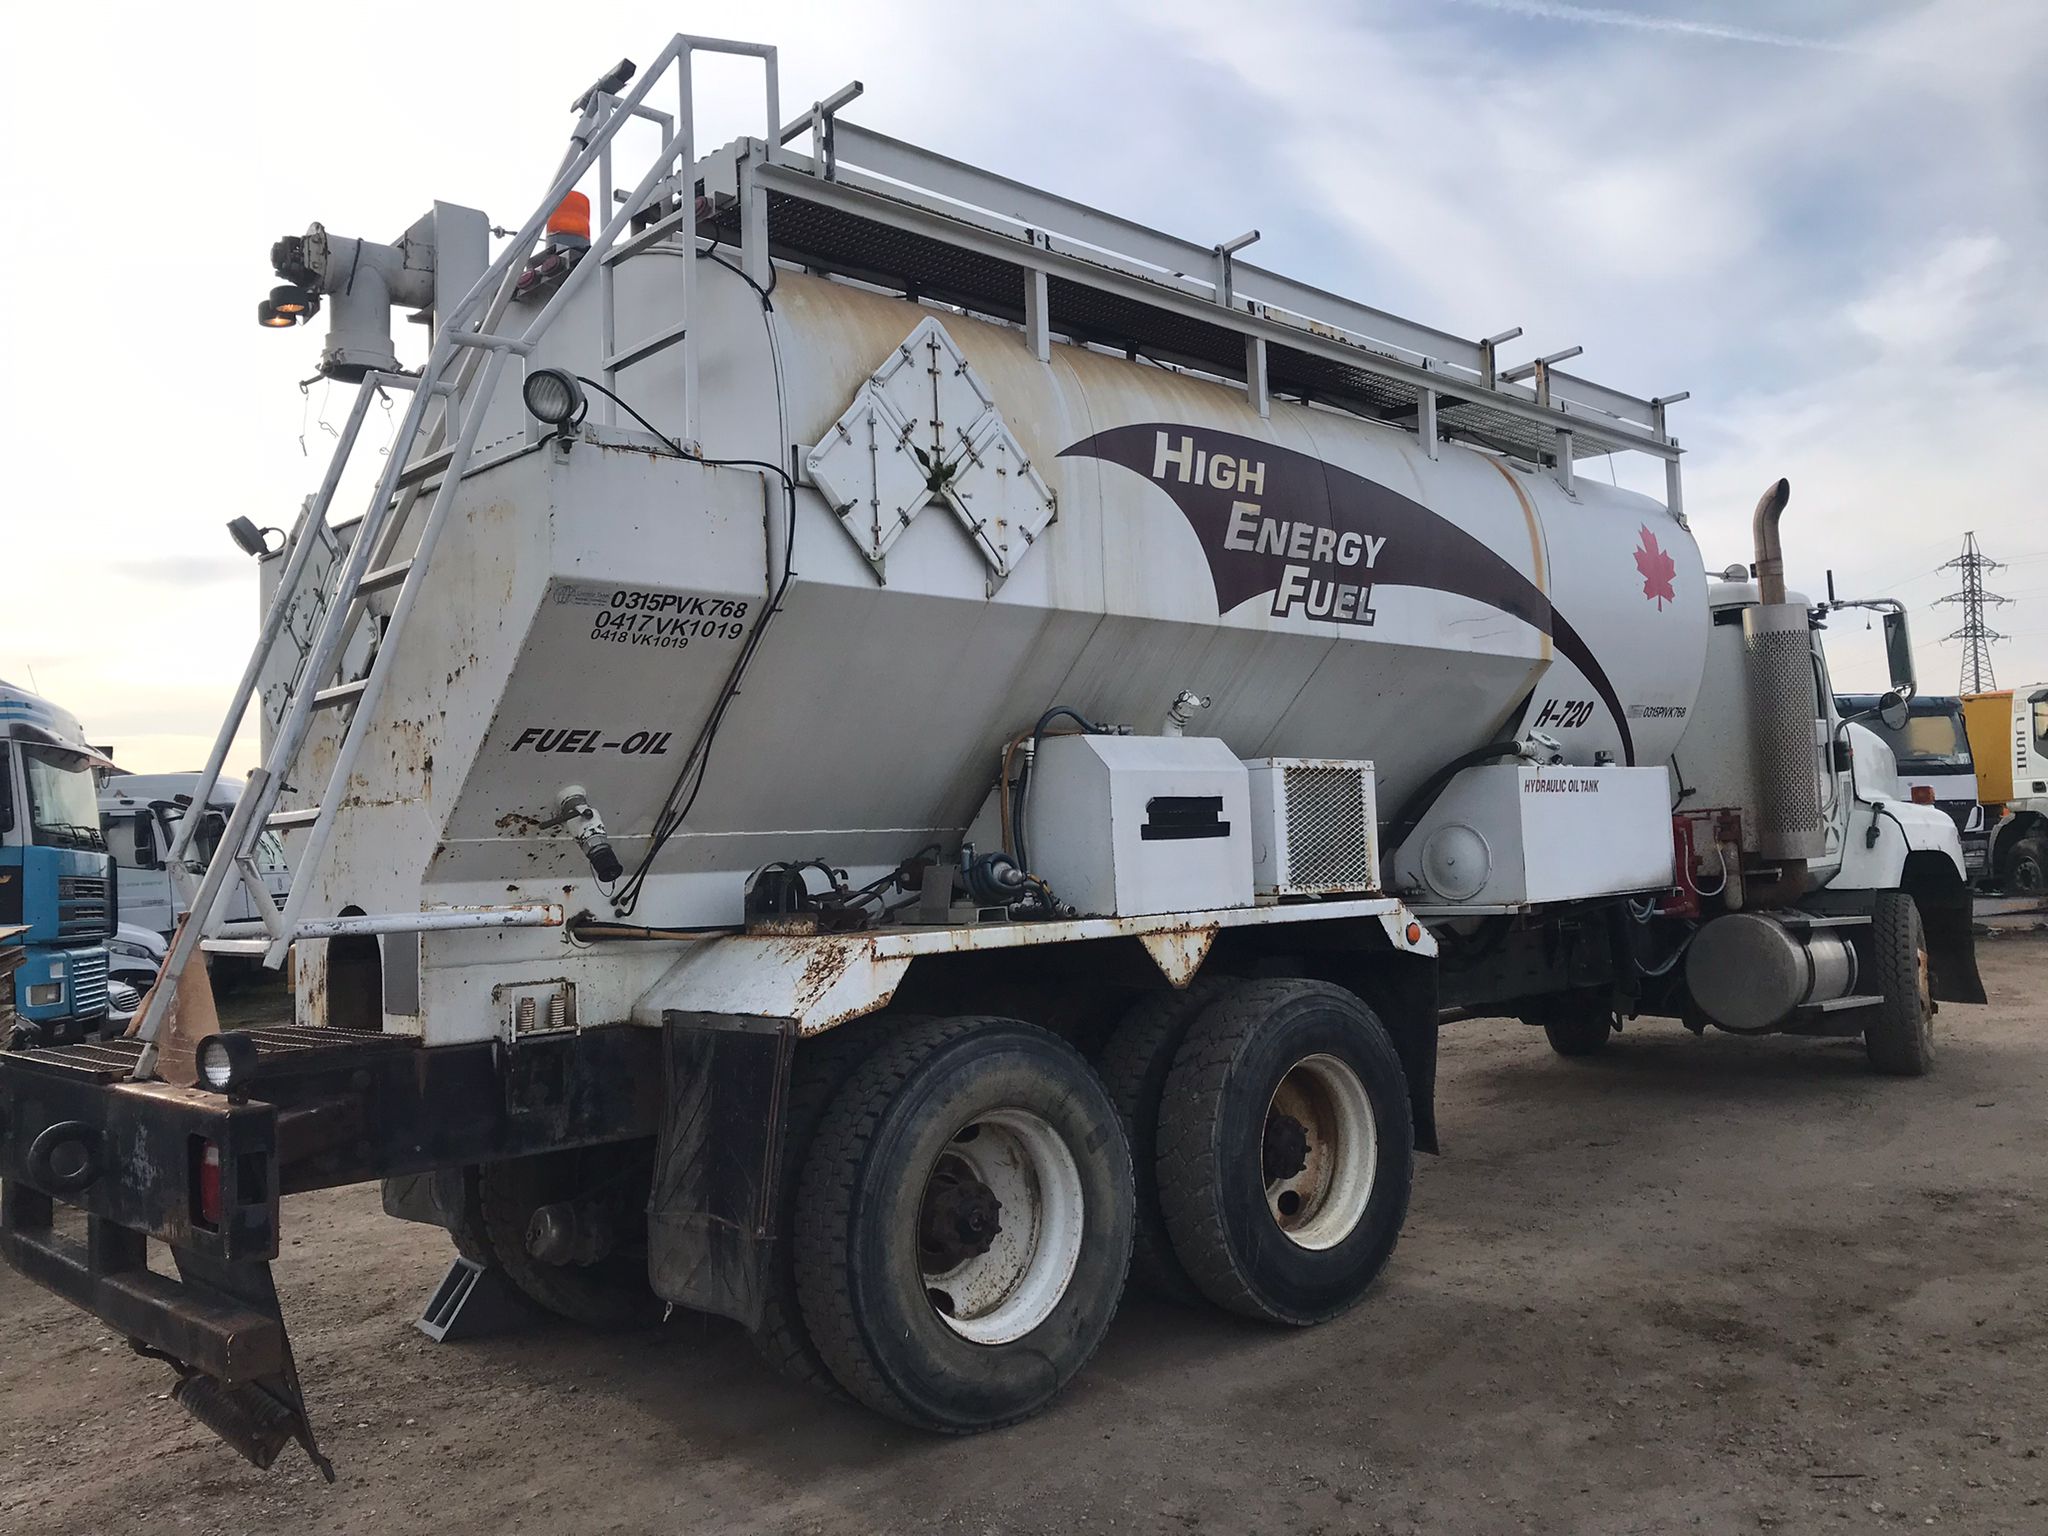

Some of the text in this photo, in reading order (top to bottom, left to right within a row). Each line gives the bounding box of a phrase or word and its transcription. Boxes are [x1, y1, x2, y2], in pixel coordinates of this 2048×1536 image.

[1152, 430, 1265, 496] HIGH
[1223, 500, 1387, 569] ENERGY
[610, 590, 748, 619] 0315PVK768
[1271, 563, 1376, 625] FUEL
[590, 628, 689, 649] 0418 VK1019
[1533, 699, 1595, 728] H-720
[510, 728, 672, 754] FUEL-OIL
[1524, 779, 1600, 793] HYDRAULIC OIL TANK
